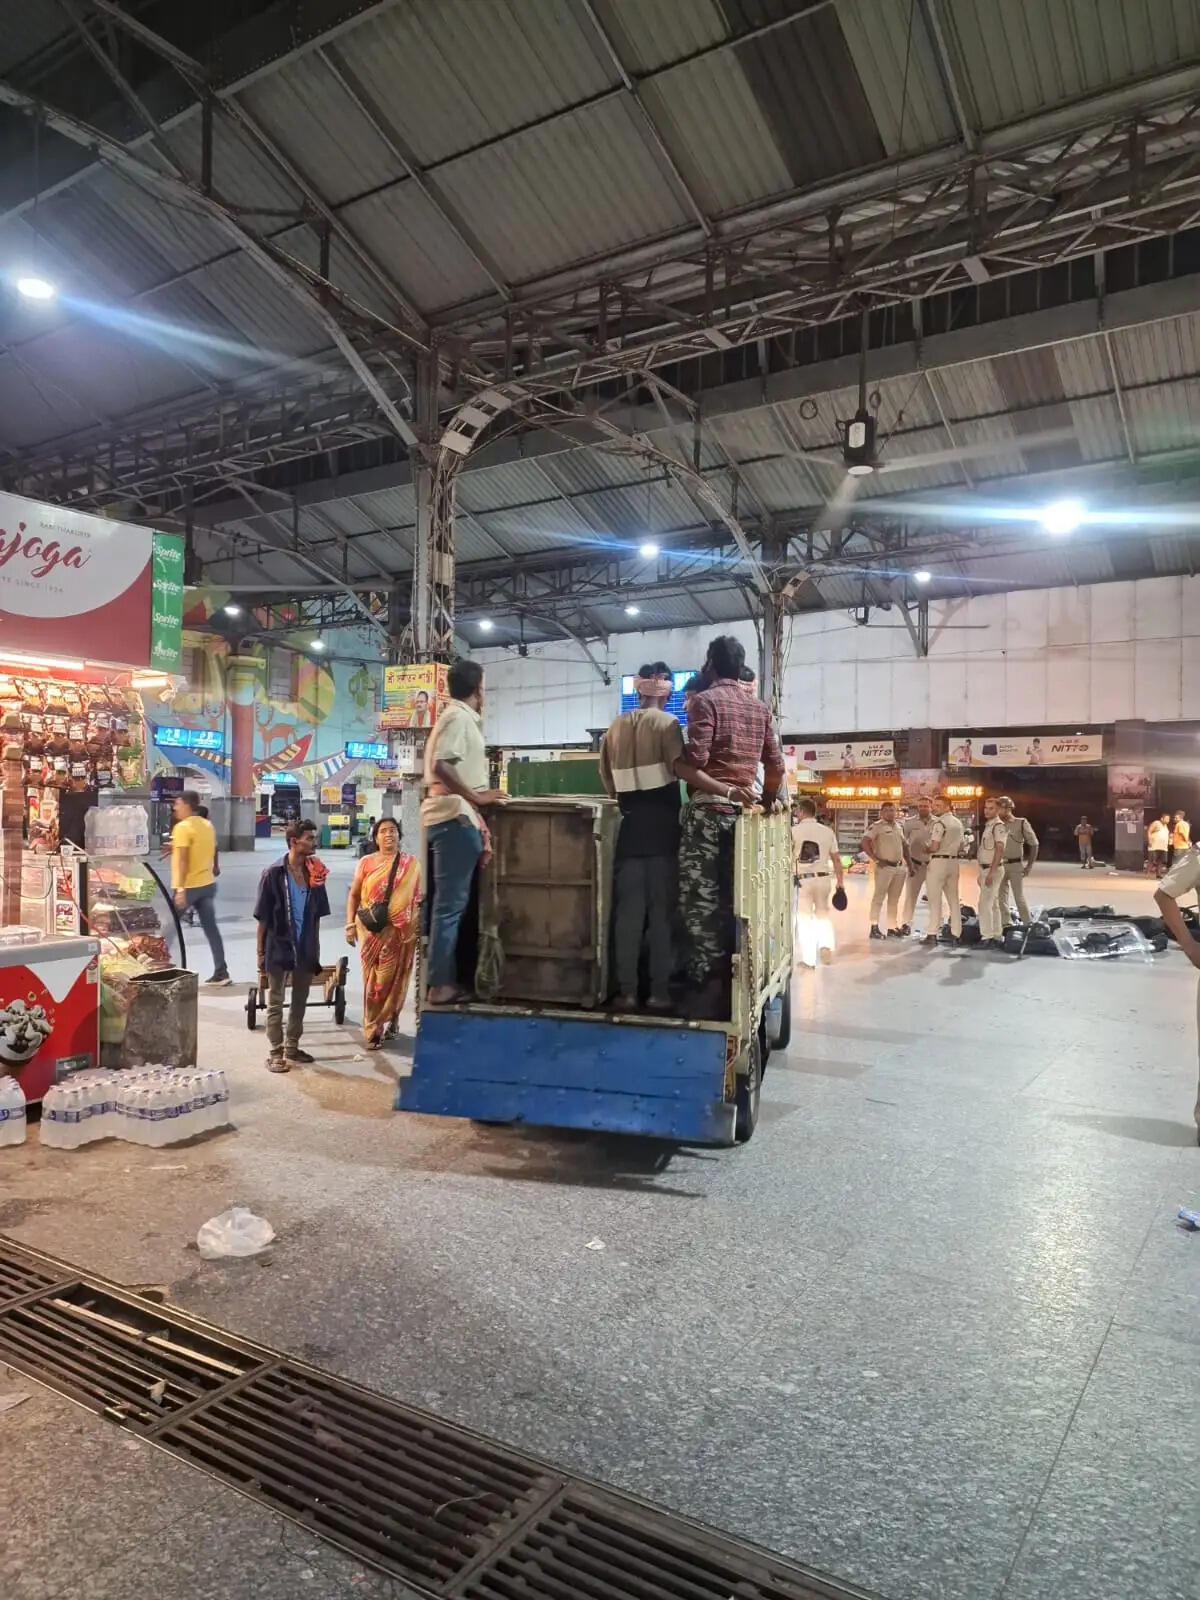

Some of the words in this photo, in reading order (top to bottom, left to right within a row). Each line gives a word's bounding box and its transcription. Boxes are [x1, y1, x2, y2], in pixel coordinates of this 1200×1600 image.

[155, 545, 182, 560] Sprite
[154, 580, 181, 592] Sprite
[153, 612, 180, 625] Sprite
[152, 646, 178, 658] Sprite
[861, 749, 892, 758] NITTO
[1051, 744, 1089, 752] NITTO
